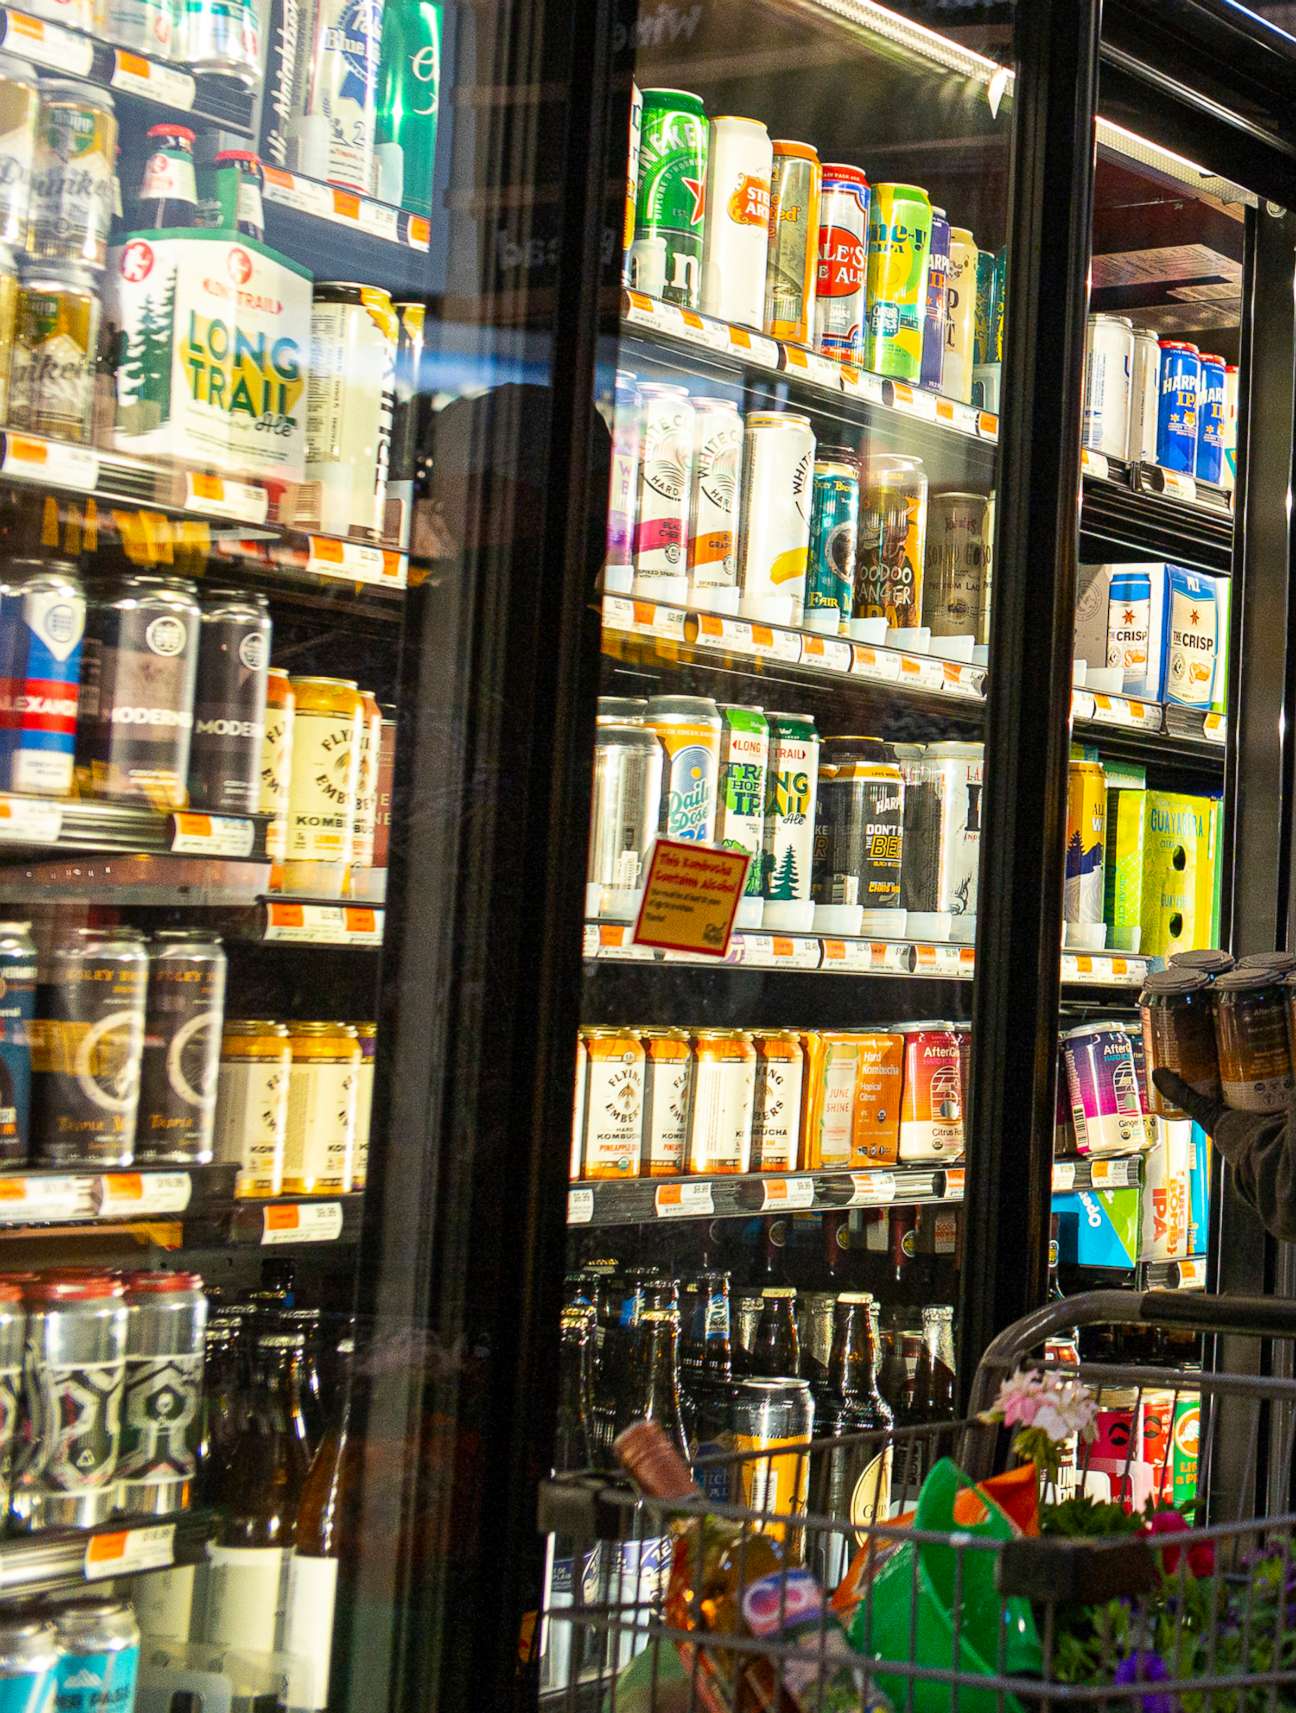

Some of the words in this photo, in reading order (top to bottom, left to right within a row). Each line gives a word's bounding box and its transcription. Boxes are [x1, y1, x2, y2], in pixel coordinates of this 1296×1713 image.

[189, 309, 300, 381] LONG
[188, 357, 298, 427] TRAIL
[254, 410, 293, 437] Ale
[651, 474, 681, 497] HARD
[857, 562, 913, 584] OODOO
[1116, 630, 1148, 642] CRISP
[1182, 632, 1214, 651] CRISP
[782, 812, 805, 826] Ale
[828, 1087, 850, 1099] JUNE
[826, 1103, 850, 1113] SHINE
[1152, 1188, 1168, 1243] IPA
